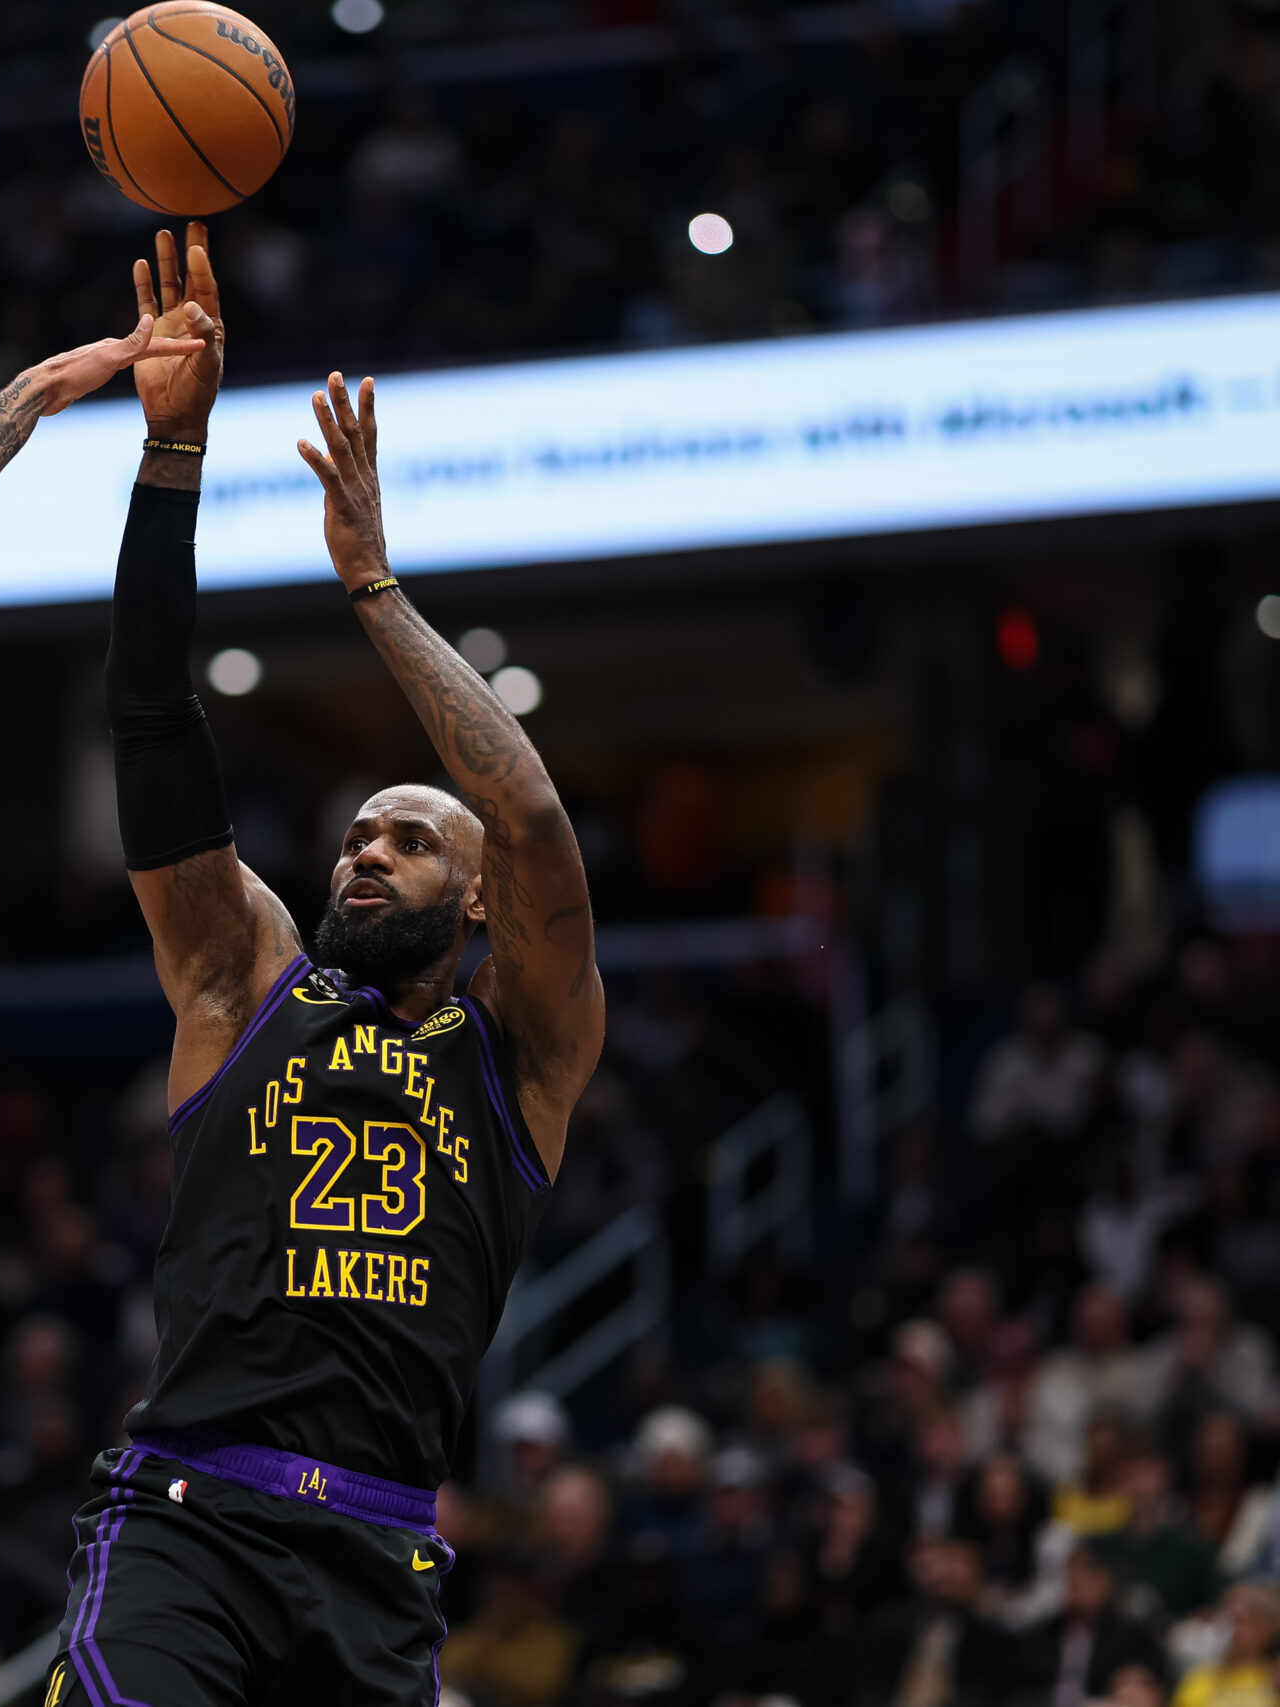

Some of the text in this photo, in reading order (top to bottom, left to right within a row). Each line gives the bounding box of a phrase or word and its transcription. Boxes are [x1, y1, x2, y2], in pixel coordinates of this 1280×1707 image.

[172, 443, 201, 453] AKRON
[368, 585, 373, 593] I
[248, 1024, 470, 1184] LOS ANGELES
[289, 1114, 427, 1236] 23
[285, 1247, 431, 1307] LAKERS
[297, 1466, 327, 1501] LAL
